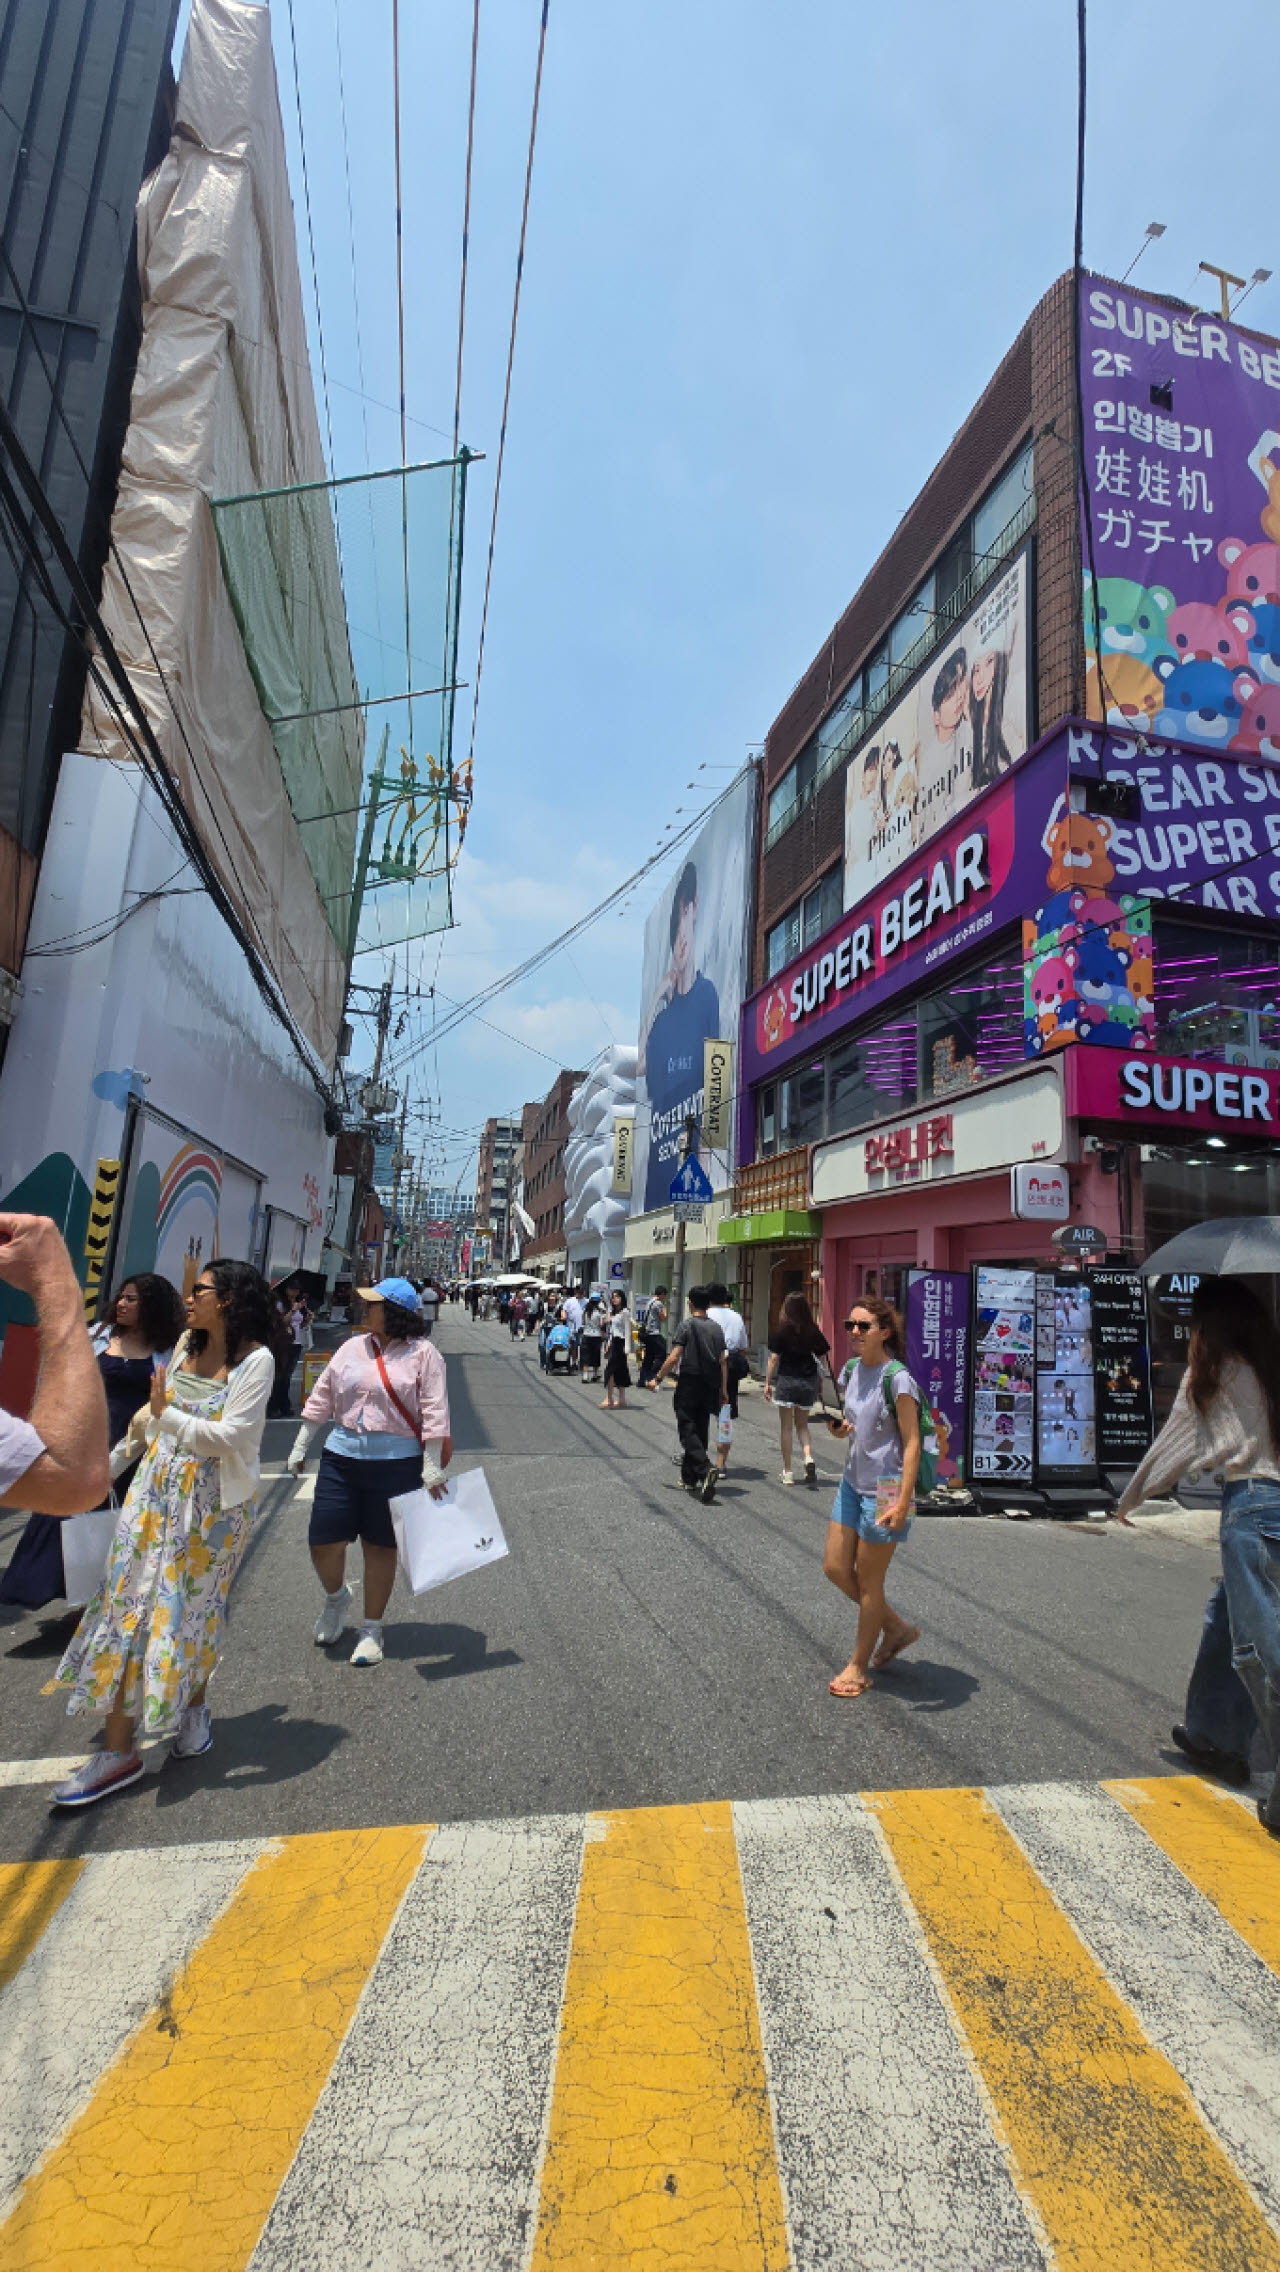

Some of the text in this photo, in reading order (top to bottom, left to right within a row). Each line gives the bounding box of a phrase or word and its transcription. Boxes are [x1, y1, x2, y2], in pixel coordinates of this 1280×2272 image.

[1089, 291, 1231, 363] SUPER
[1091, 348, 1132, 377] 2F
[1093, 400, 1213, 458] 인형뽑기
[1095, 446, 1213, 514] 娃娃机
[1096, 508, 1213, 563] ガチャ
[1114, 818, 1261, 876] SUPER
[789, 832, 990, 1022] SUPER BEAR
[1123, 1060, 1273, 1121] SUPER
[1072, 1228, 1096, 1241] AIR
[922, 1279, 942, 1360] 인형뽑기
[974, 1456, 991, 1469] B1
